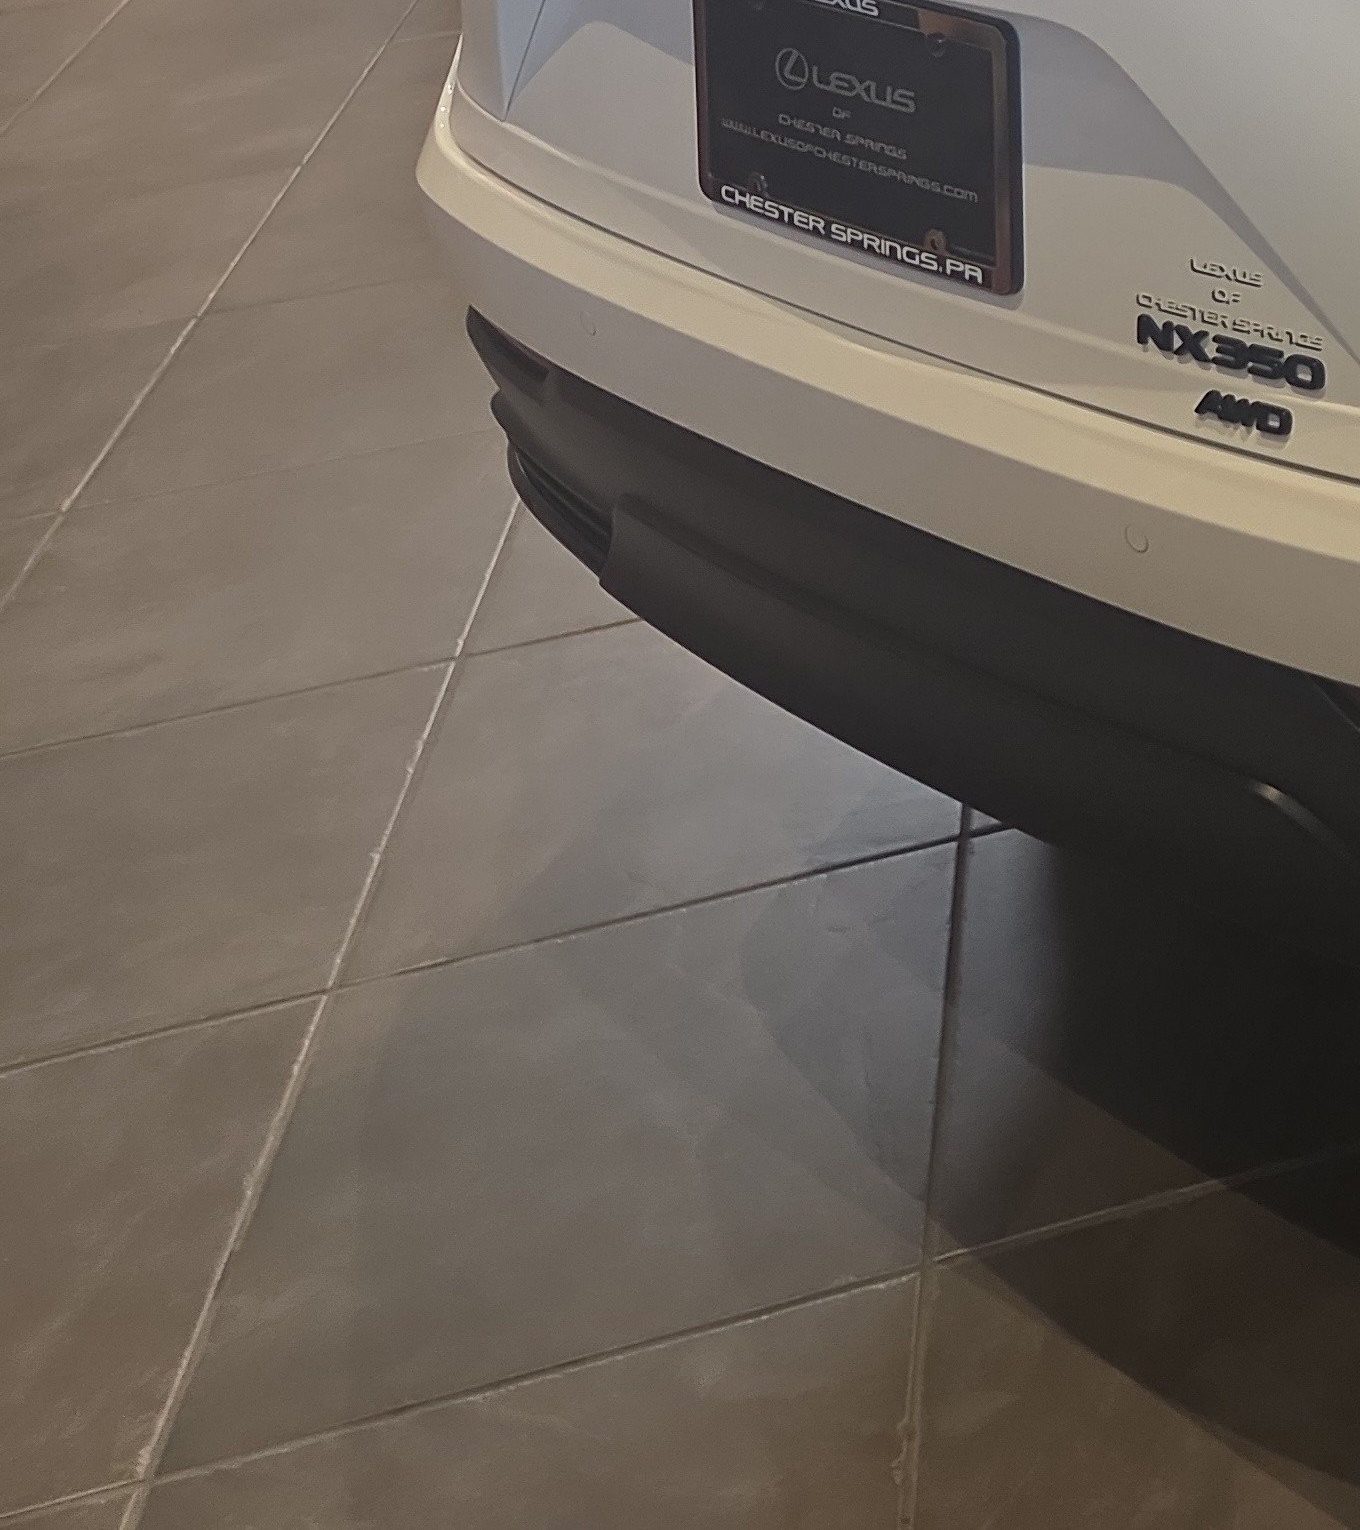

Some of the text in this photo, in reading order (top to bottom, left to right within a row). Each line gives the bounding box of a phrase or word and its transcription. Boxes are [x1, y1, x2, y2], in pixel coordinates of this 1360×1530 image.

[811, 65, 916, 114] LEXUS
[831, 106, 852, 121] OF
[777, 112, 908, 161] CHESTER SPRINGS
[720, 183, 826, 236] CHESTER
[1189, 257, 1263, 288] LEXUS
[1211, 288, 1241, 305] OF
[1135, 292, 1324, 353] CHESTER SPRINGS
[1194, 388, 1294, 437] AWD
